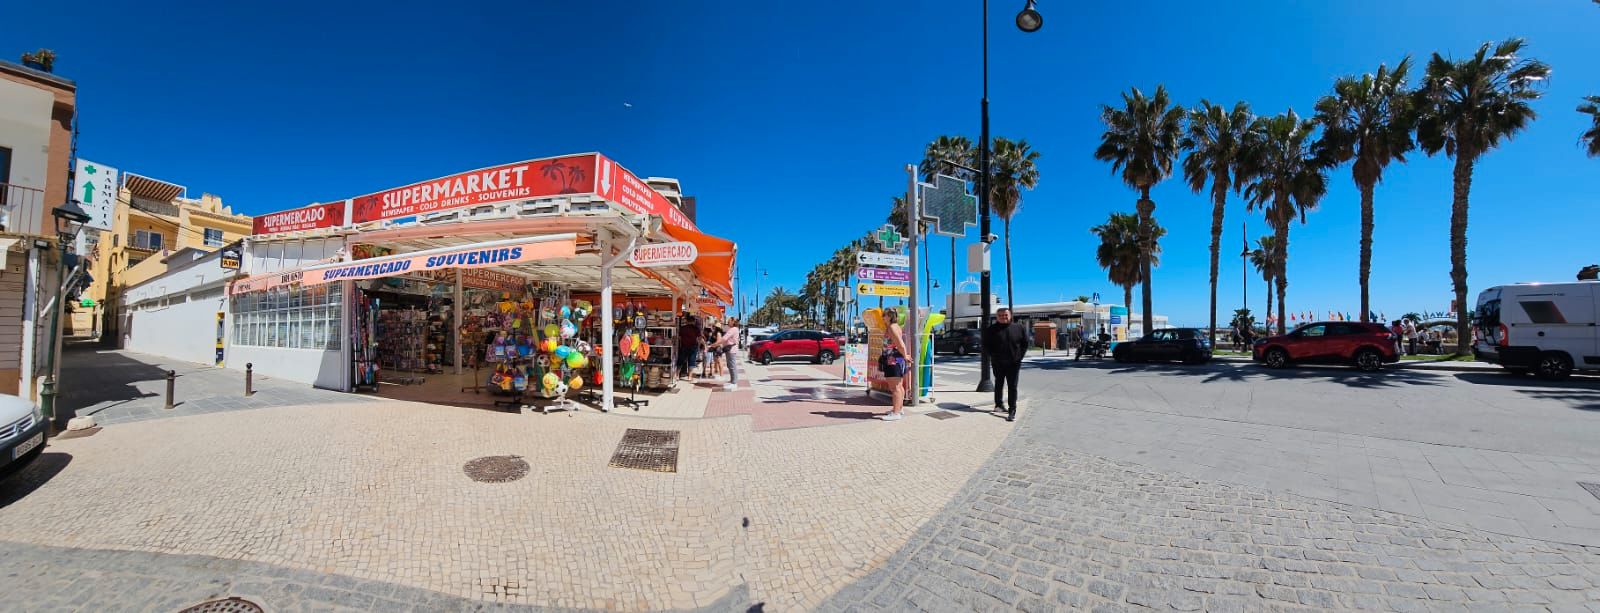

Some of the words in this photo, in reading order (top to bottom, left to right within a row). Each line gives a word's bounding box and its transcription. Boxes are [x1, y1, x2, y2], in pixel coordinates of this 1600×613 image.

[101, 170, 112, 226] FARMACIA
[382, 166, 528, 210] SUPERMARKET
[381, 206, 413, 218] NEWSPAPER
[420, 202, 438, 212] COLD
[441, 196, 469, 207] DRINKS
[478, 187, 530, 201] SOUVENIRS
[264, 207, 325, 229] SUPERMERCADO
[426, 247, 523, 269] SOUVENIRS
[634, 245, 692, 260] SUPERMERCADO
[323, 260, 412, 281] SUPERMERCADO
[462, 267, 524, 286] SUPERMERCADO
